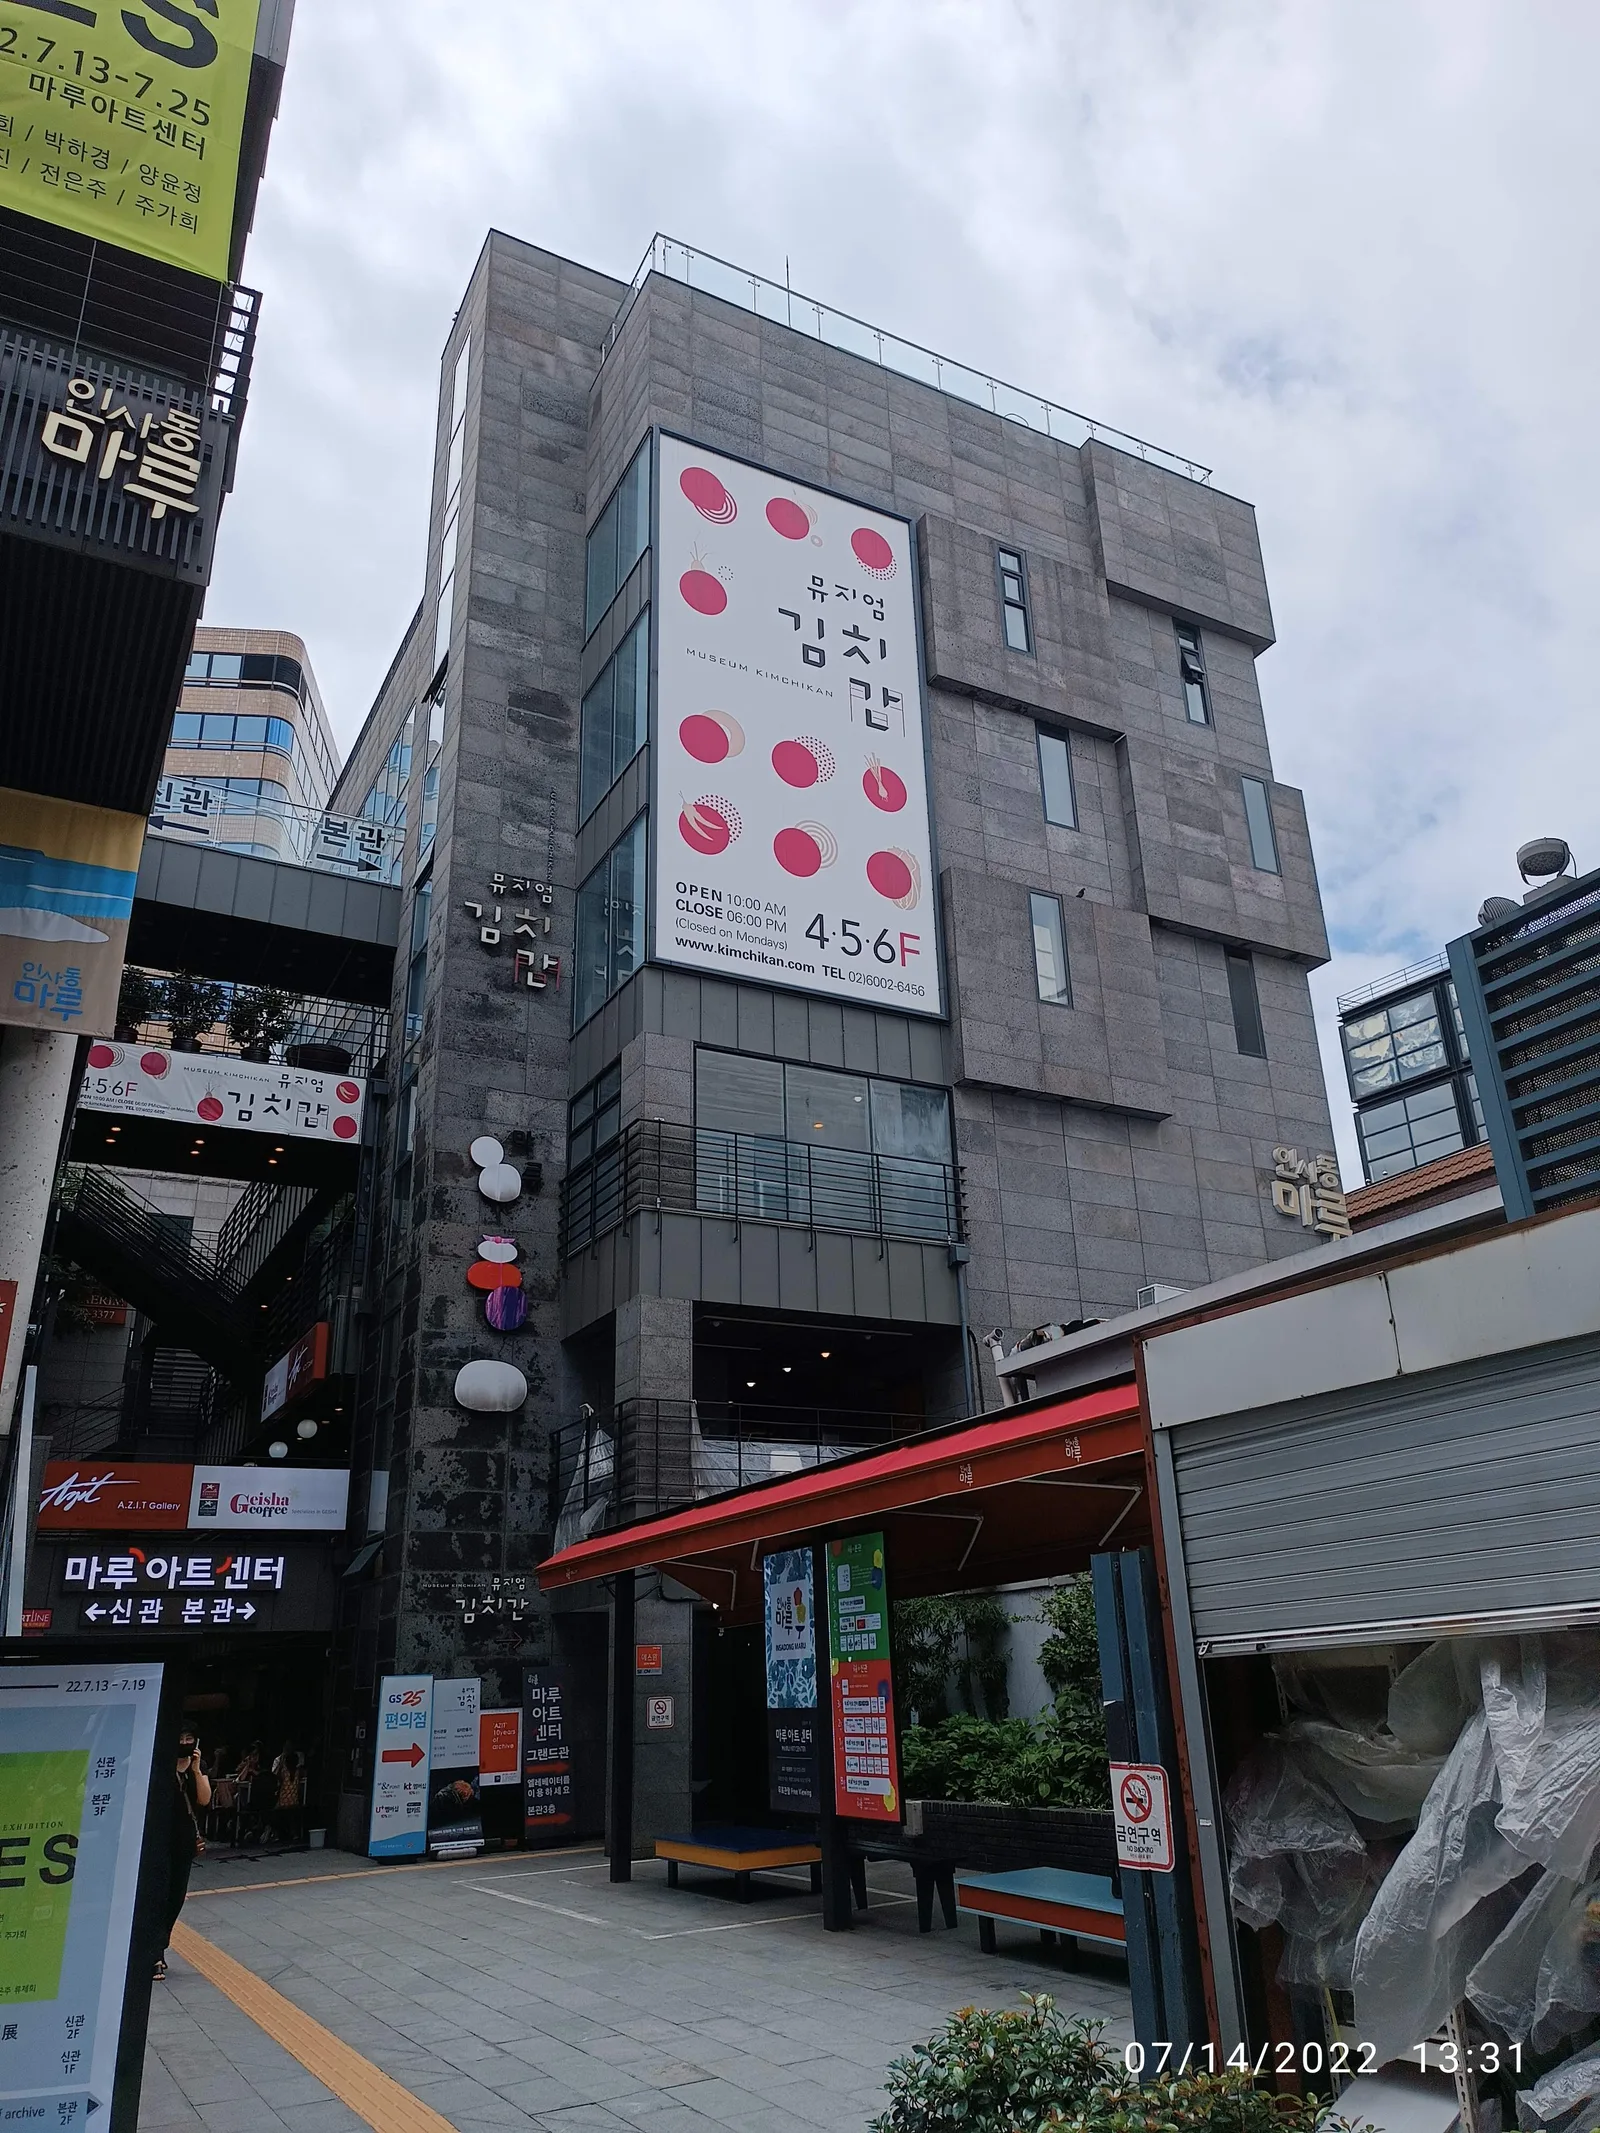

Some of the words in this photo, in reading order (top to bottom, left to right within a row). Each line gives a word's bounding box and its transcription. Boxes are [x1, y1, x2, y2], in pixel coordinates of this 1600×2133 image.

[28, 73, 206, 160] 마루아트센터
[44, 129, 110, 170] 박하경
[139, 163, 201, 204] 양윤정
[40, 161, 107, 200] 전은주
[134, 193, 198, 235] 주가희
[66, 378, 201, 452] 인사동
[41, 411, 201, 519] 마루
[807, 574, 885, 622] 뮤지엄
[686, 647, 749, 672] MUSEUM
[756, 668, 834, 698] KIMCHIKAN
[320, 817, 386, 855] 본관
[489, 872, 553, 904] 뮤지엄
[675, 881, 722, 903] OPEN
[726, 893, 761, 911] 10:00
[764, 904, 787, 917] AM
[675, 898, 724, 920] CLOSE
[726, 910, 762, 928] 06:00
[766, 919, 787, 934] PM
[675, 917, 716, 936] (Closed
[719, 927, 733, 940] on
[736, 930, 788, 952] Mondays)
[675, 935, 815, 975] www.kimchikan.com
[822, 964, 846, 981] TEL
[848, 970, 925, 997] 02)6002-6456
[21, 961, 82, 992] 인사동
[13, 980, 83, 1022] 마루
[183, 1066, 220, 1076] MUSEUM
[223, 1072, 270, 1083] KIMCHIKAN
[278, 1074, 324, 1094] 뮤지엄
[1271, 1180, 1353, 1241] 마루
[117, 1500, 147, 1510] A.Z.I.T
[148, 1501, 181, 1511] Gallery
[230, 1491, 290, 1515] Geisha
[248, 1505, 289, 1518] coffee
[491, 1577, 526, 1591] 뮤지엄
[108, 1598, 163, 1625] 신관
[181, 1598, 235, 1623] 본관
[455, 1595, 530, 1624] 김치간
[65, 1680, 109, 1693] 22.7.13
[121, 1679, 146, 1691] 7.19
[532, 1686, 563, 1703] 마루
[388, 1689, 426, 1707] GS25
[384, 1711, 427, 1730] 편의점
[532, 1705, 563, 1723] 아트
[536, 1723, 563, 1742] 센터
[96, 1756, 116, 1768] 신관
[526, 1746, 570, 1762] 그랜드관
[94, 1768, 116, 1779] 1-3F
[404, 1782, 412, 1790] kt
[91, 1793, 112, 1806] 본관
[93, 1806, 107, 1817] 3F
[1116, 1824, 1162, 1846] 금연구역
[65, 2014, 86, 2029] 신관
[2, 2024, 18, 2041] 展
[67, 2029, 80, 2040] 2F
[60, 2049, 81, 2064] 신관
[64, 2063, 76, 2075] 1F
[4, 2106, 46, 2119] archive
[57, 2101, 78, 2115] 본관
[59, 2115, 73, 2126] 2F
